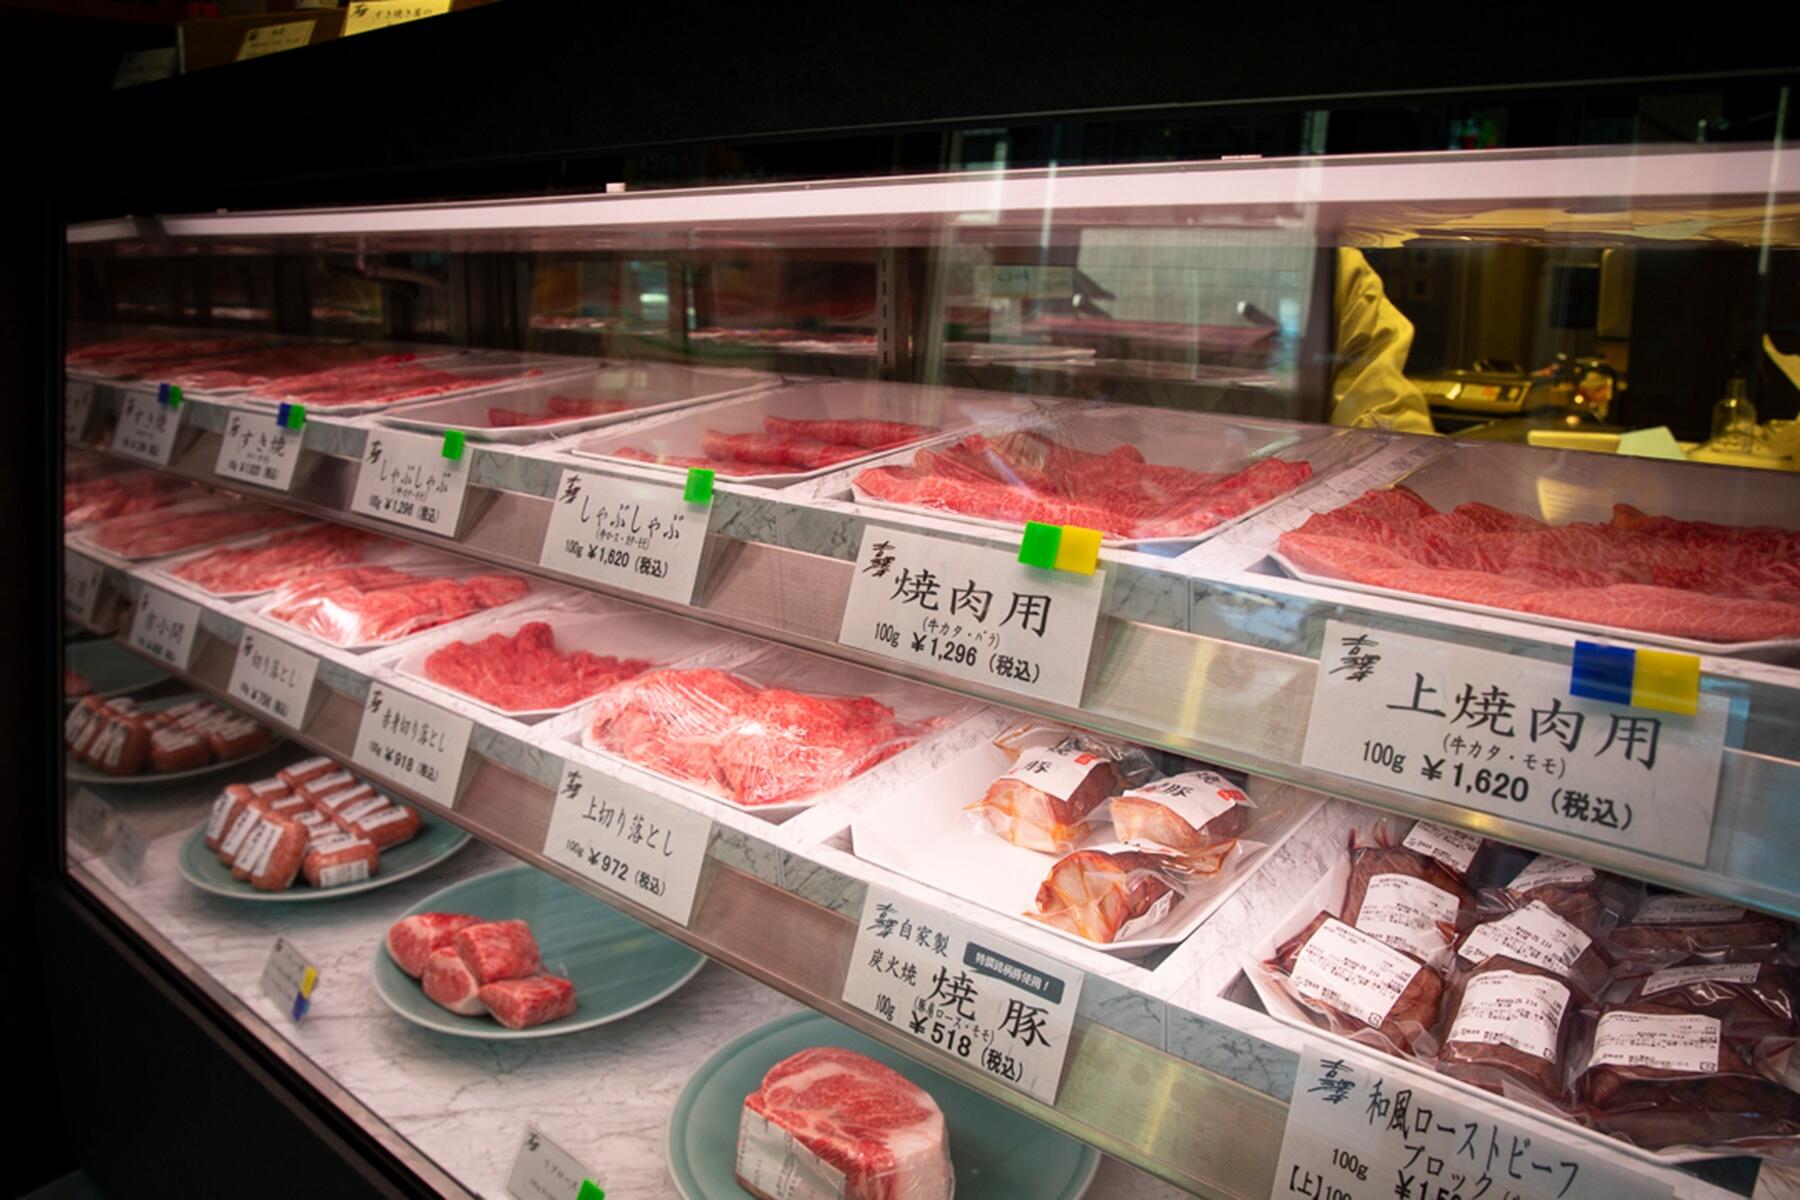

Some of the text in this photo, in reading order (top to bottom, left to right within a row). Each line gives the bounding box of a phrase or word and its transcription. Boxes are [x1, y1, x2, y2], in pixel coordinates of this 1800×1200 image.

[380, 459, 452, 493] しゃぶしゃぶ
[580, 495, 685, 540] しゃぶしゃぶ
[587, 543, 630, 568] ¥1,620
[634, 555, 669, 580] (税込)
[889, 567, 1053, 638] 焼肉用
[874, 621, 1041, 684] 100g ¥1,296 (税込)
[1385, 671, 1663, 772] 上焼肉用
[1441, 733, 1568, 780] (牛カタ・モモ)
[1361, 739, 1635, 831] 100g ¥1,620 (税込)
[581, 795, 674, 858] 上切り落とし
[588, 847, 630, 882] ¥972
[634, 870, 667, 897] (税込)
[899, 917, 951, 959] 自家製
[867, 947, 919, 988] 炭火焼
[926, 964, 1052, 1049] 焼豚
[874, 991, 1024, 1084] 100g ¥518 (税込)
[1331, 1147, 1369, 1182] 100g
[1365, 1077, 1581, 1199] 和風ローストビーフ
[1402, 1144, 1494, 1200] ブロック
